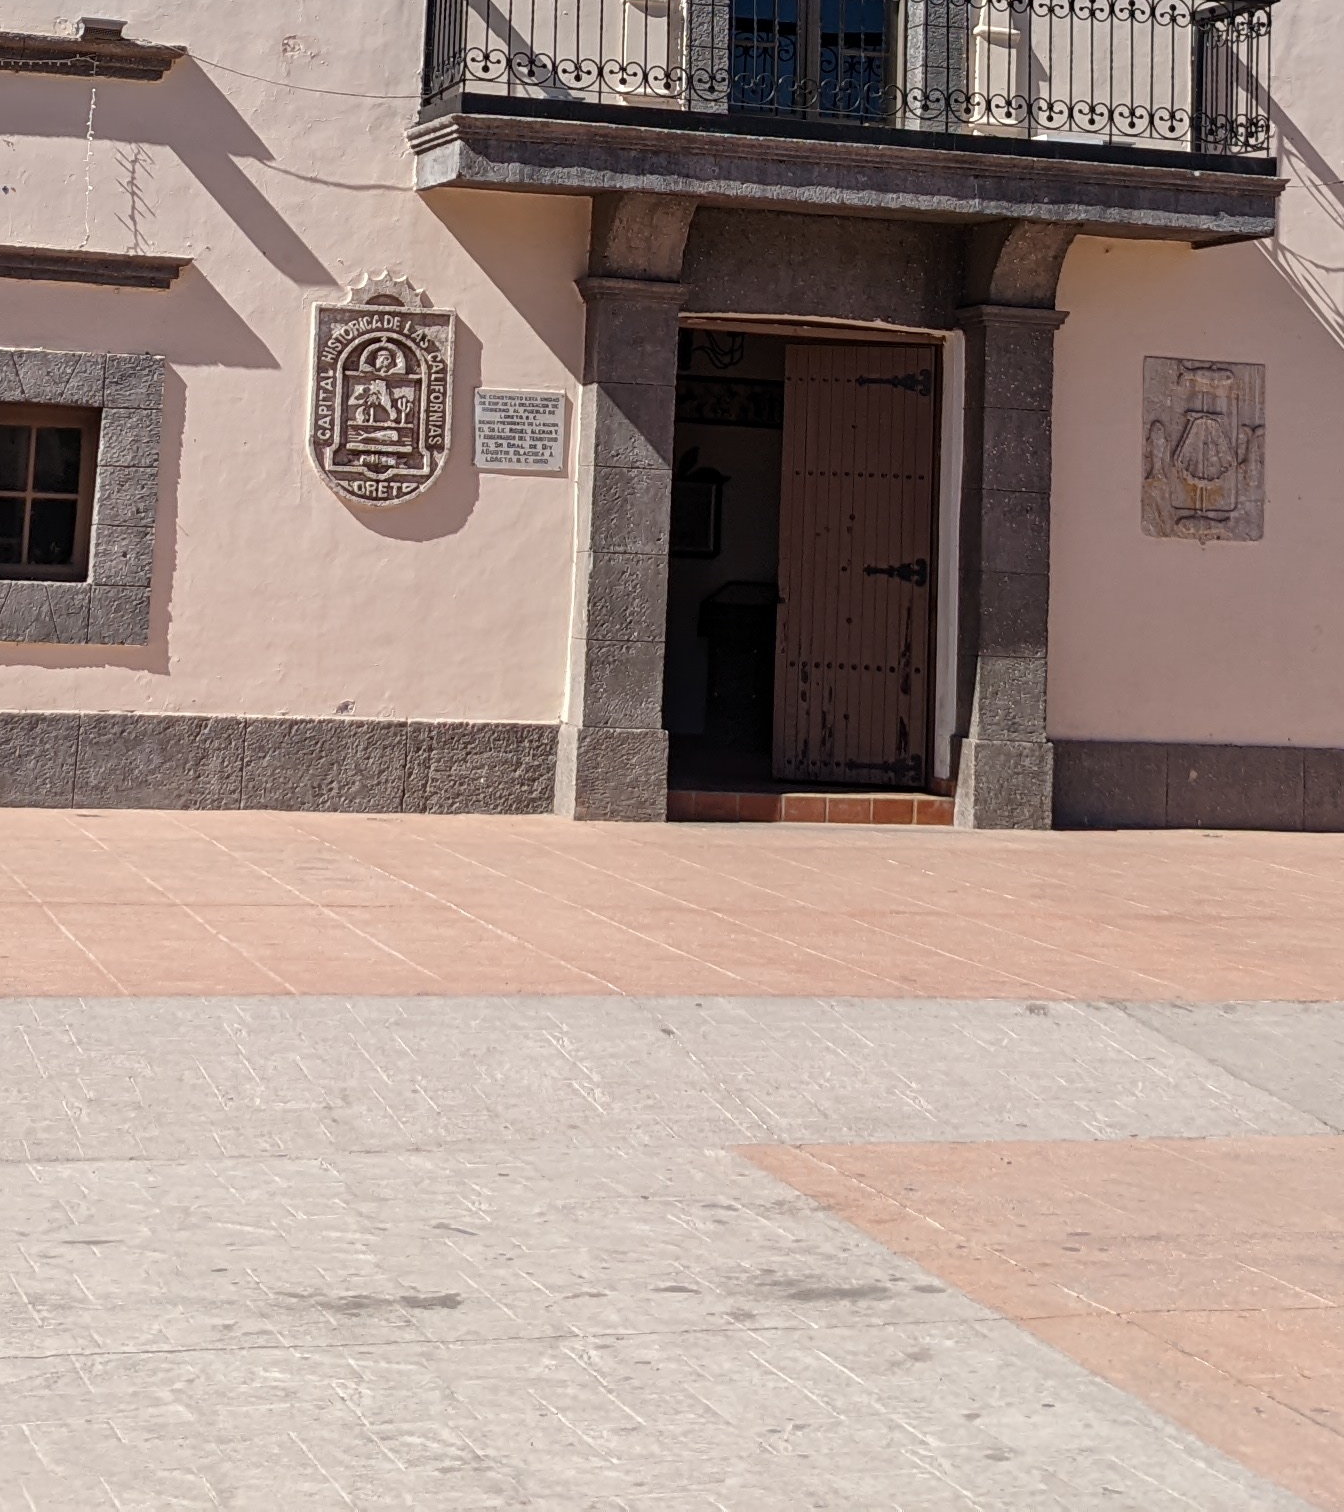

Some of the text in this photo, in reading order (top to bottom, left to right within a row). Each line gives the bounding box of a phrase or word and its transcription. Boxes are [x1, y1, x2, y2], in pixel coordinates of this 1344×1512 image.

[317, 314, 445, 446] CAPITAL HISTORICA DE LAS CALIFORNIAS
